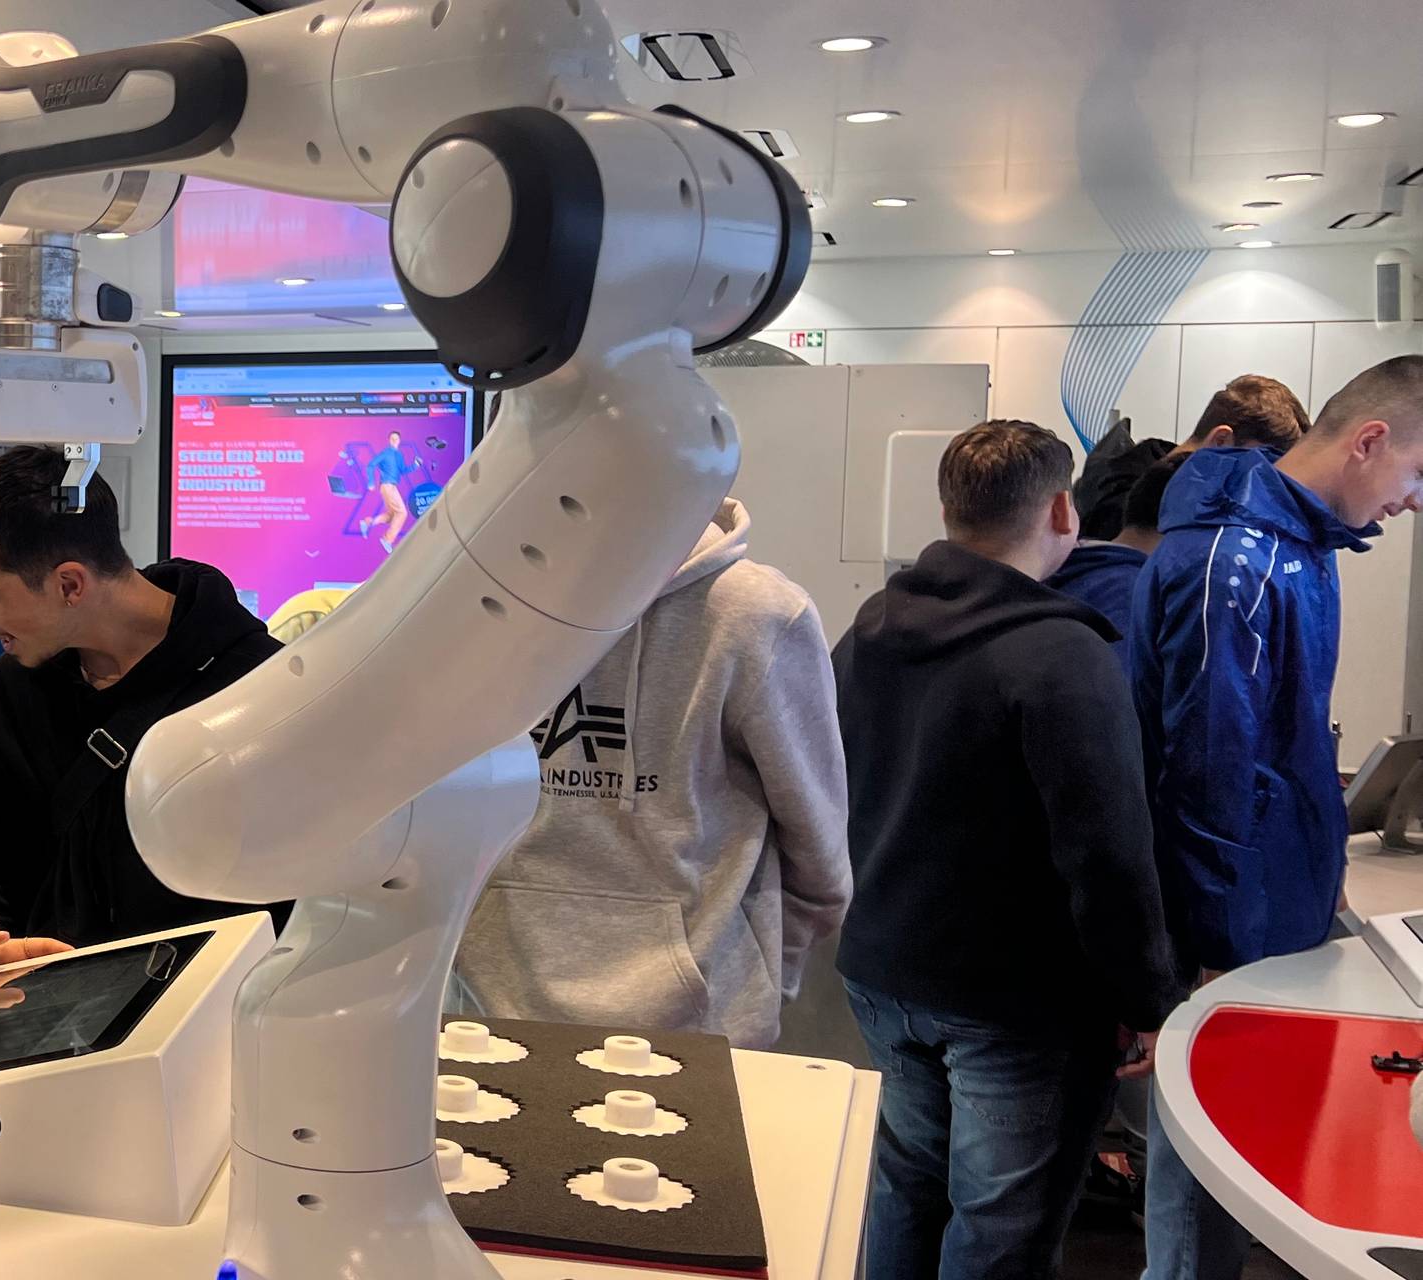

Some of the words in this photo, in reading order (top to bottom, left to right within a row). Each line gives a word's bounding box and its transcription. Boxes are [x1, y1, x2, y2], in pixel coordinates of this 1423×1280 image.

[178, 450, 224, 462] STEIG
[226, 450, 254, 462] EIN
[255, 450, 274, 462] IN
[275, 450, 305, 463] DIE
[178, 464, 262, 477] ZUKUNFTS-
[178, 478, 266, 491] INDUSTRIE!
[547, 767, 659, 792] INDUSTRES
